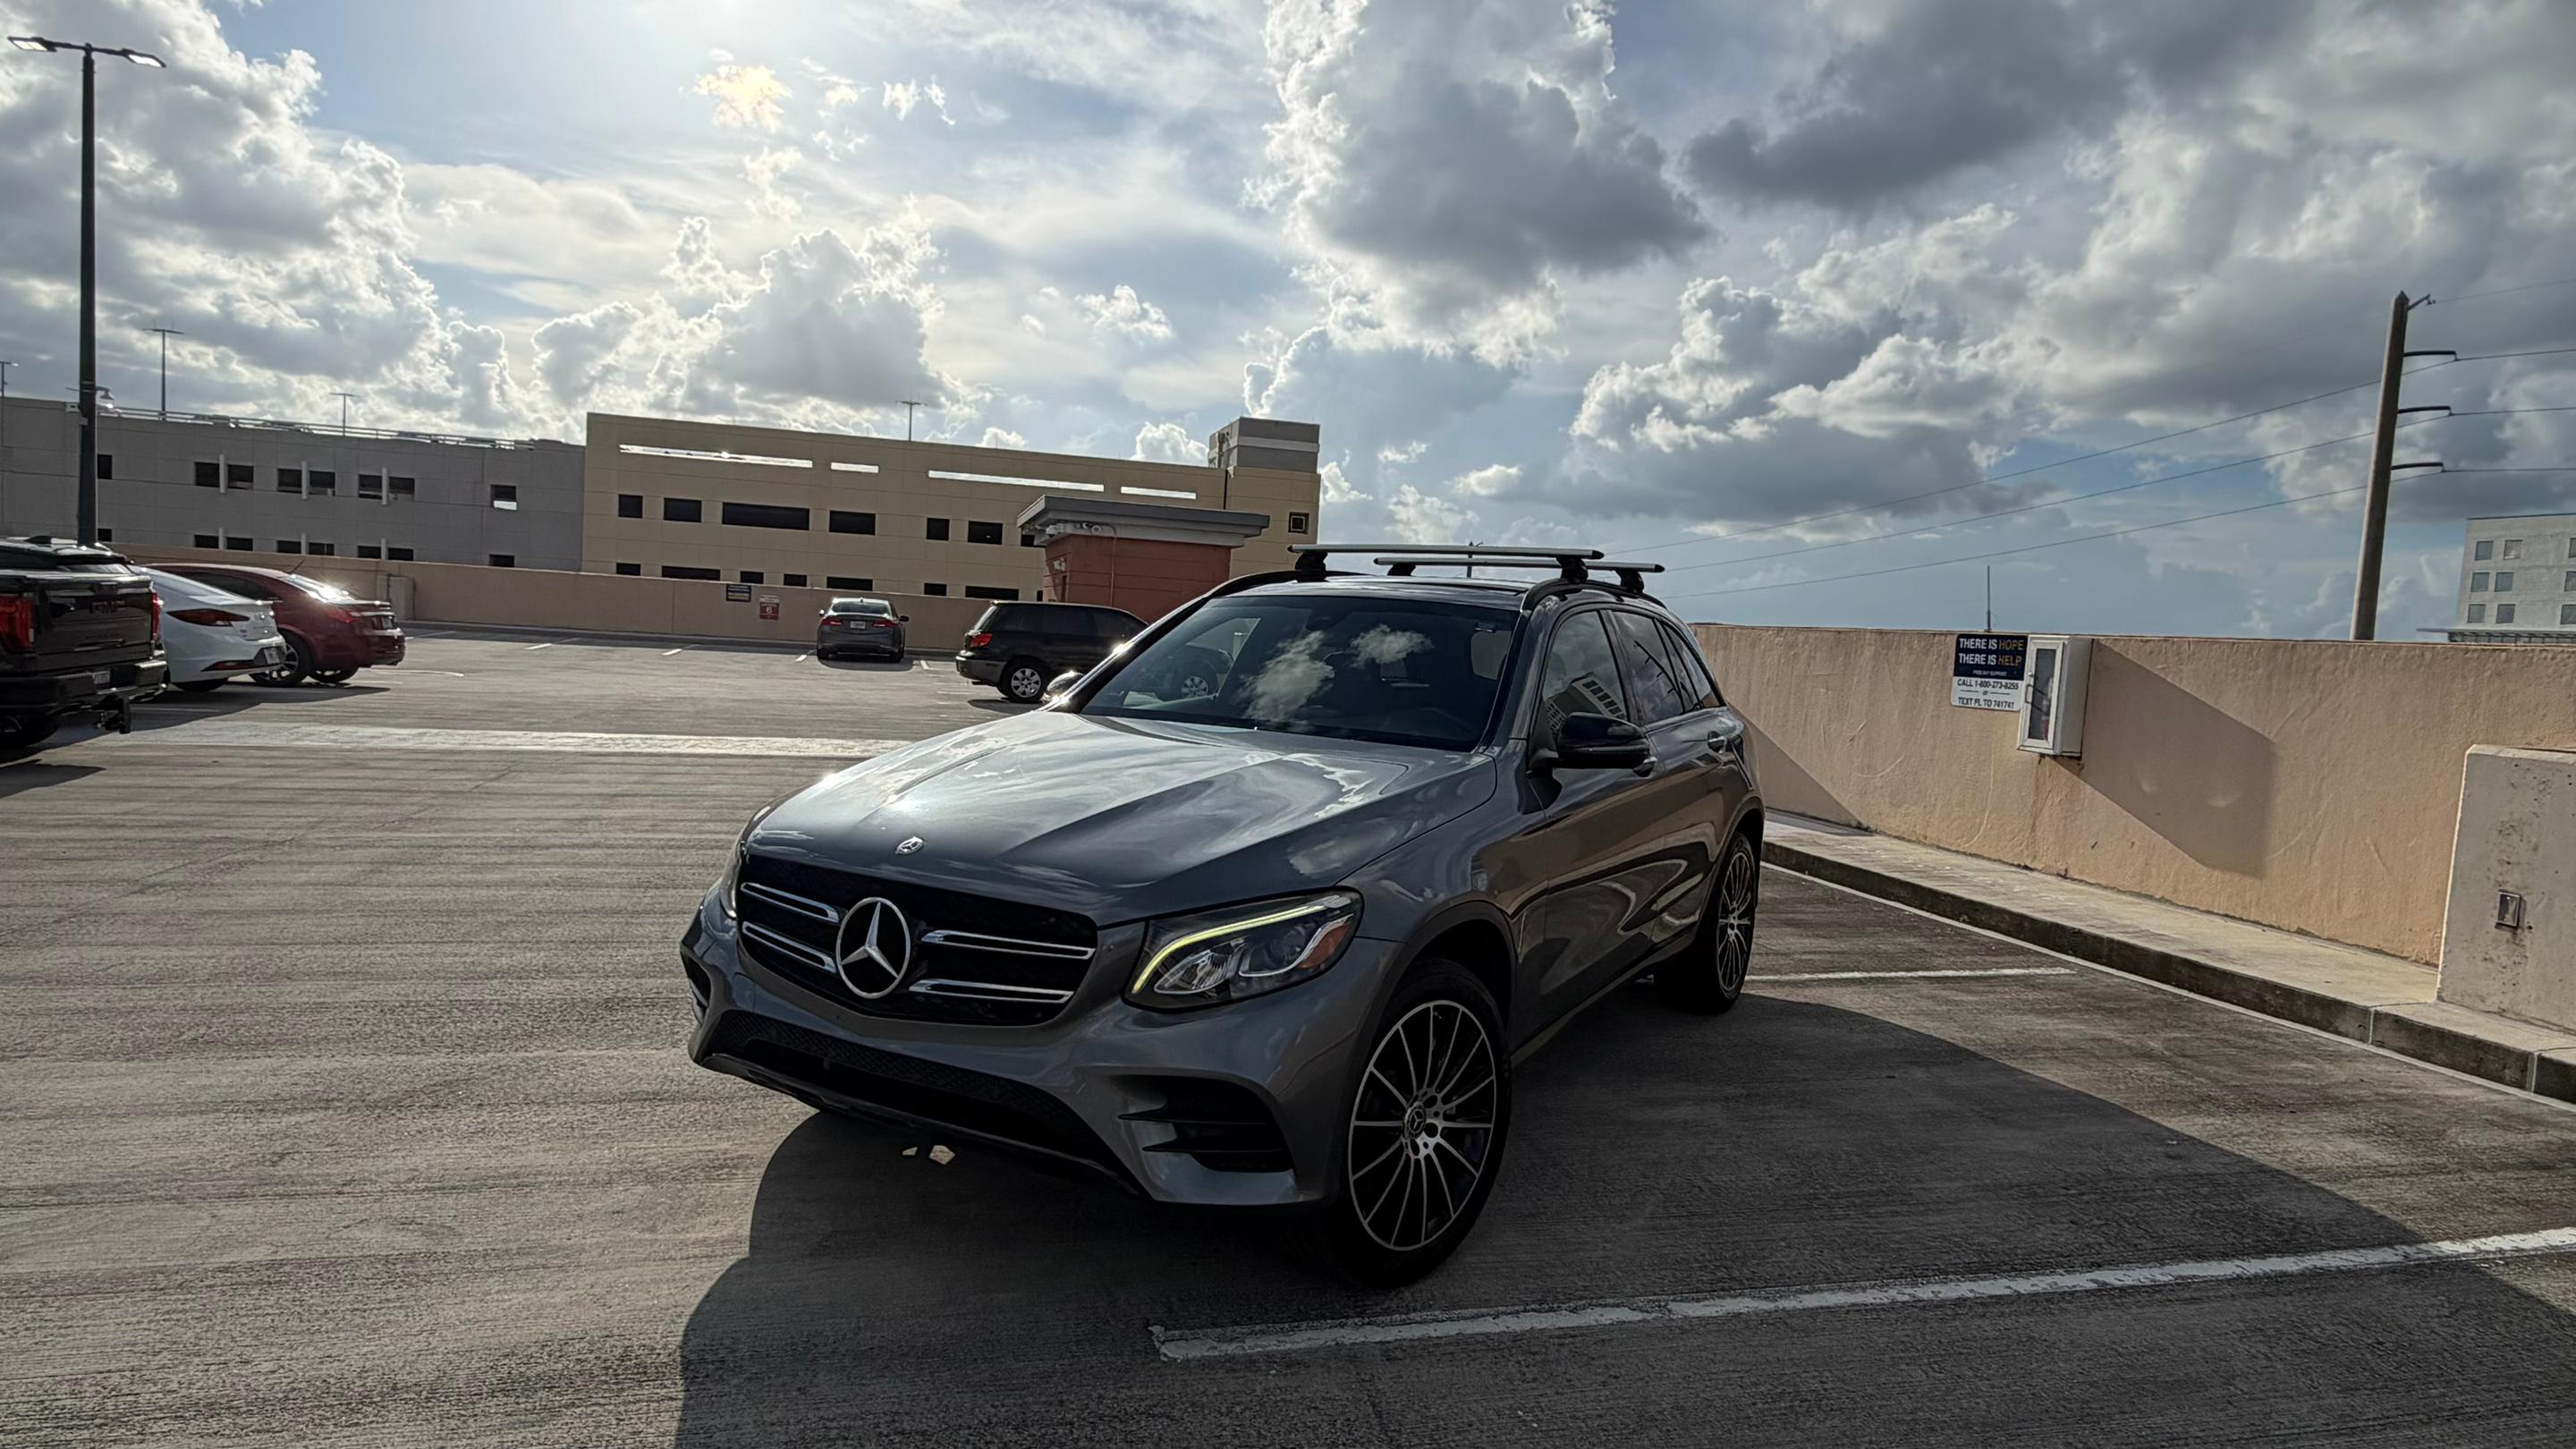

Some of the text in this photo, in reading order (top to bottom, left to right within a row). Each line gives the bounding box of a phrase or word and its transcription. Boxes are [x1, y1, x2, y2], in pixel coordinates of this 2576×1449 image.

[1959, 638, 2025, 651] THERE IS HOPE
[1958, 653, 2022, 666] THERE IS HELP
[1957, 678, 1973, 687] CALL
[1958, 697, 2014, 708] TEXT FL TO 741741
